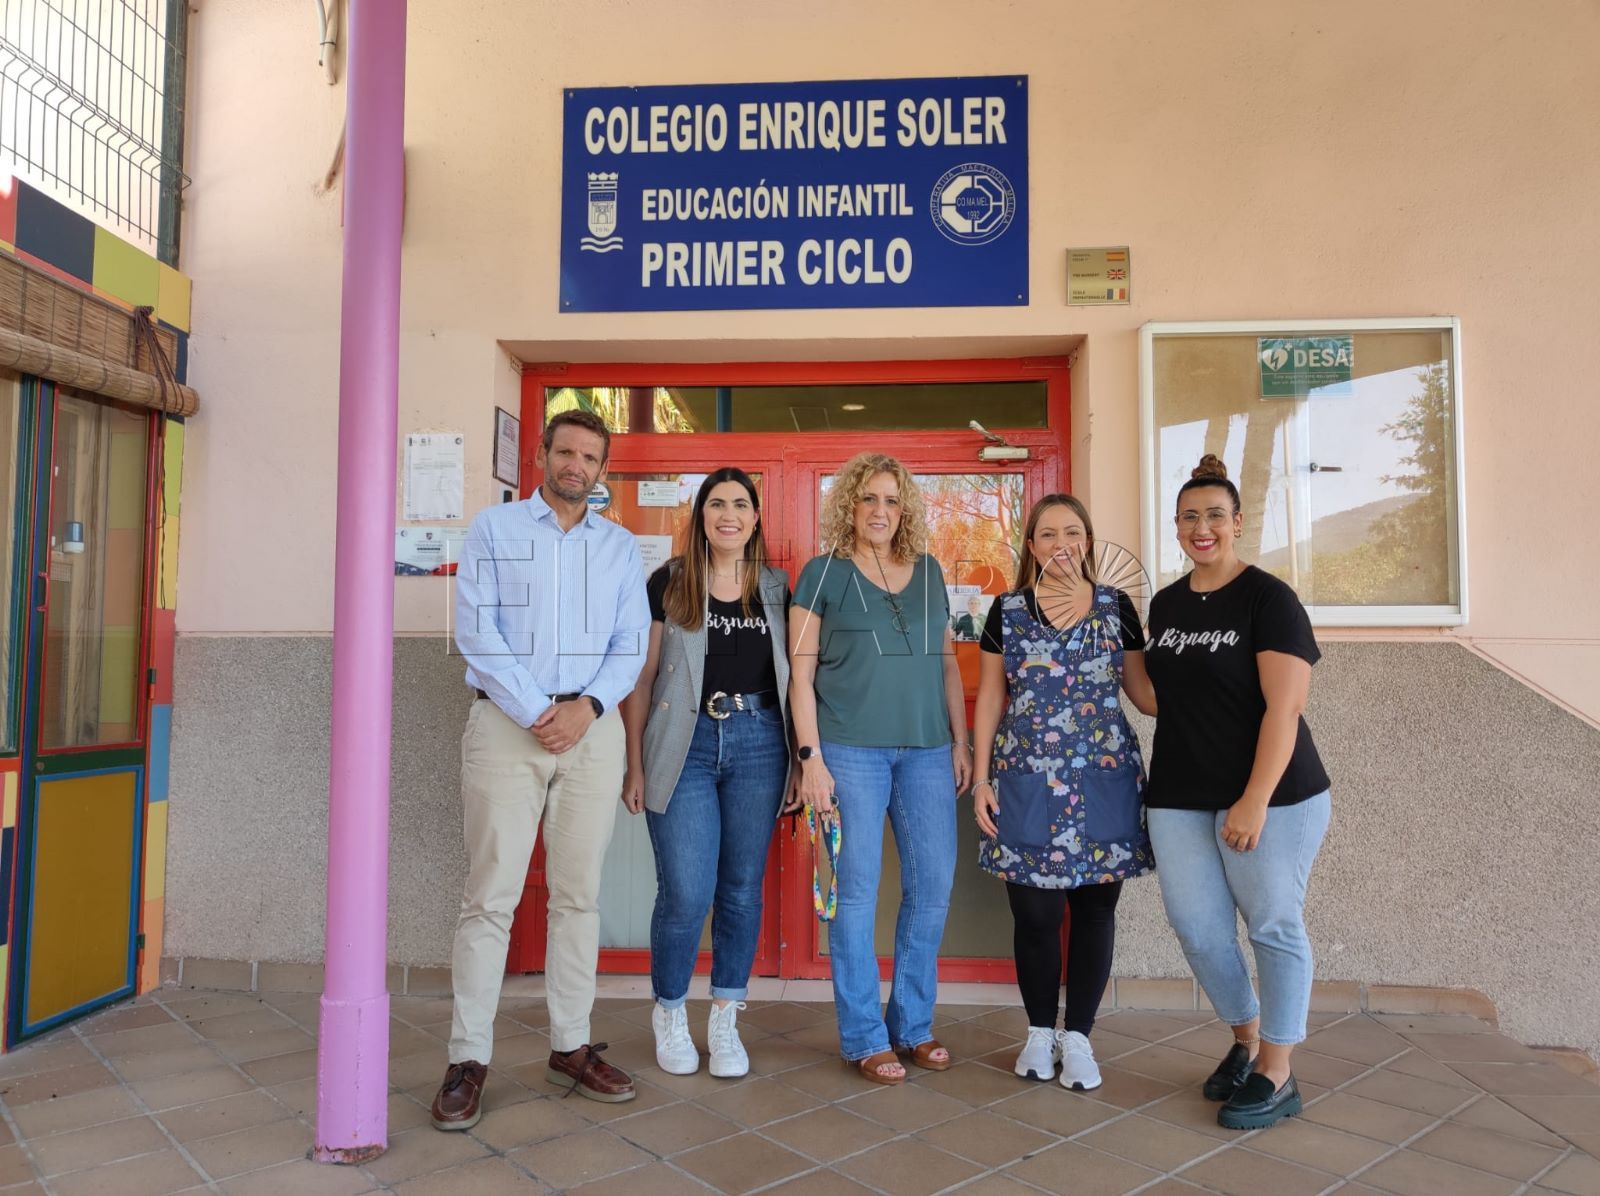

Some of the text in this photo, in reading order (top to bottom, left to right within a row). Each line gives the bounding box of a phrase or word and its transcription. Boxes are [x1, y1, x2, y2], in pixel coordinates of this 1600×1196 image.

[584, 96, 1007, 155] COLEGIO ENRIQUE SOLER
[642, 178, 914, 221] EDUCACIÓN INFANTIL
[641, 237, 913, 288] PRIMER CICLO
[706, 610, 769, 636] Biznag
[1157, 627, 1240, 655] Biznaga
